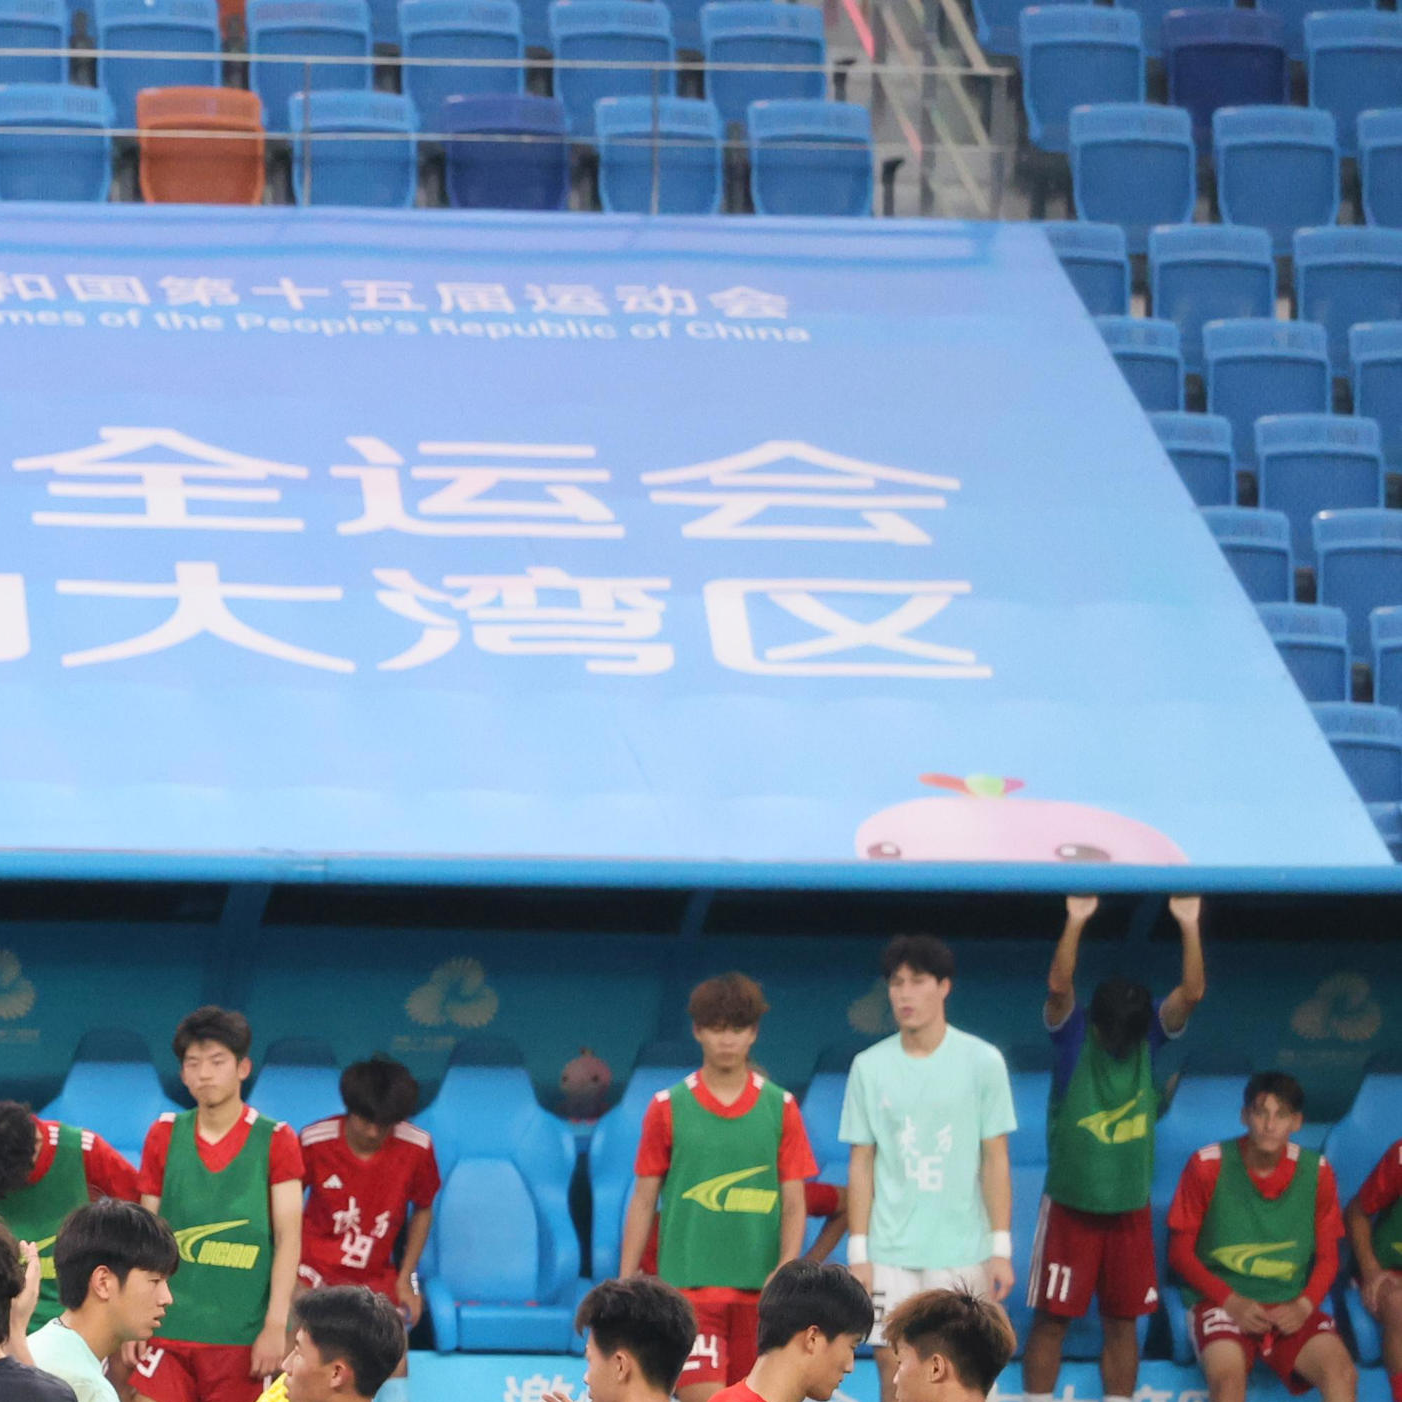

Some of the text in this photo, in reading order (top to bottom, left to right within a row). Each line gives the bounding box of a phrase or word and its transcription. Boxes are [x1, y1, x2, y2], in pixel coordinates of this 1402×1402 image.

[99, 306, 140, 330] of
[154, 311, 224, 332] the
[235, 312, 418, 338] People's
[429, 315, 618, 341] Republic
[628, 318, 672, 340] of
[686, 319, 811, 343] China
[1047, 1262, 1071, 1302] 11
